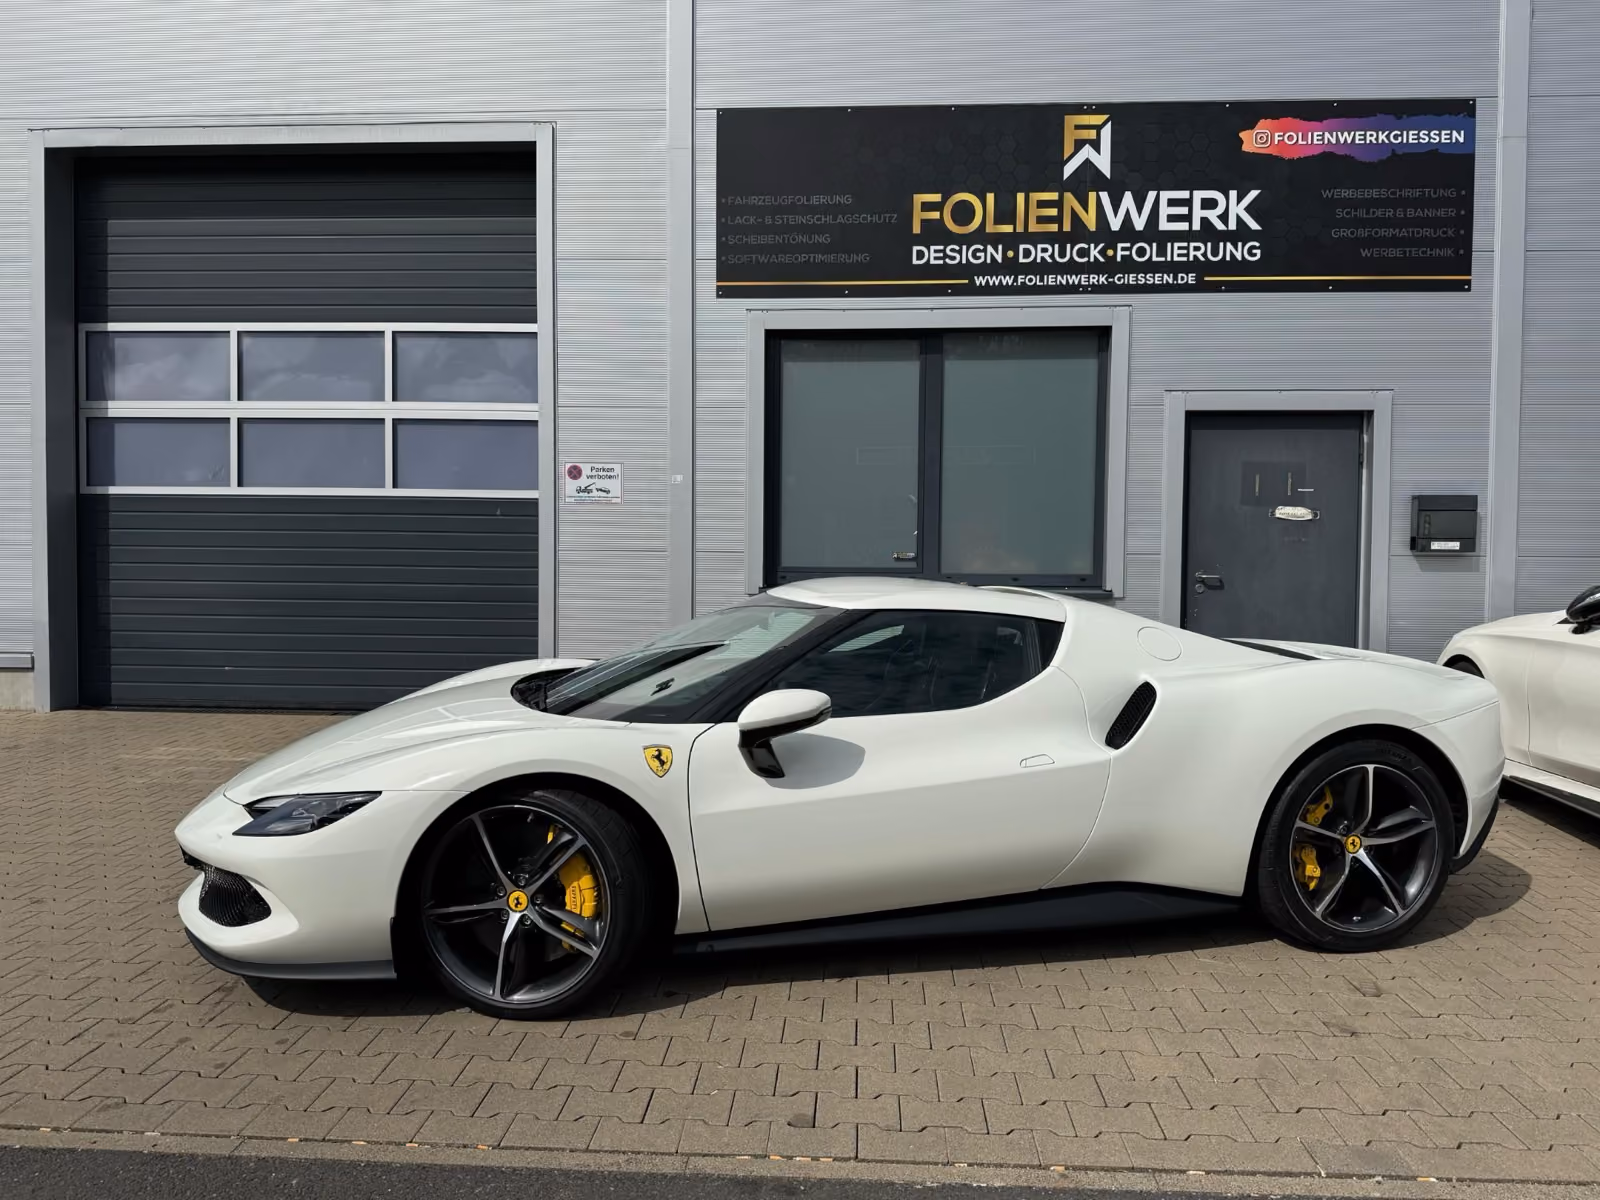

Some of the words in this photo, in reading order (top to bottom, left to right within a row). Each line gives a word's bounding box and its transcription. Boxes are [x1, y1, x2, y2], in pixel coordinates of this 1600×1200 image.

[1274, 129, 1466, 145] FOLIENWERKGIESSEN
[1321, 187, 1457, 199] WERBEBESCHRIFTUNG
[727, 194, 853, 206] FAHRZEUGFOLIERUNG
[912, 189, 1262, 235] FOLIENWERK
[1335, 208, 1394, 219] SCHILDER
[1407, 207, 1457, 218] BANNER
[727, 215, 762, 225] LACK-
[774, 213, 898, 225] STEINSCHLAGSCHUTZ
[727, 232, 831, 245] SCHEIBENTÖNUNG
[727, 252, 871, 265] SOFTWAREOPTIMIERUNG
[912, 243, 1003, 265] DESIGN
[1018, 242, 1106, 264] DRUCK
[1116, 240, 1262, 262] FOLIERUNG
[1360, 247, 1456, 258] WERBETECHNIK
[974, 272, 1197, 288] WWW.FOLIENWERK-GIESSEN.DE
